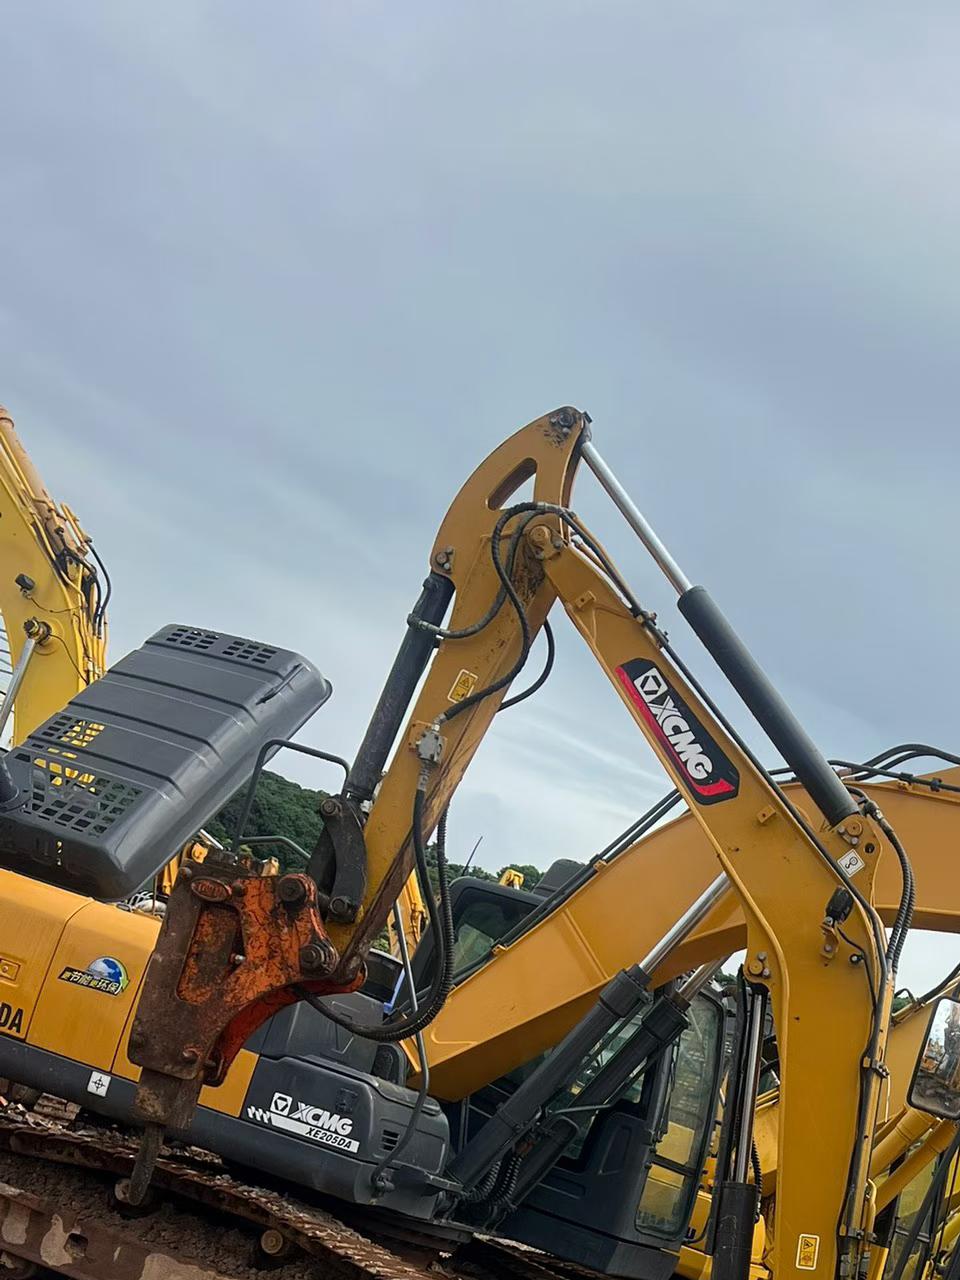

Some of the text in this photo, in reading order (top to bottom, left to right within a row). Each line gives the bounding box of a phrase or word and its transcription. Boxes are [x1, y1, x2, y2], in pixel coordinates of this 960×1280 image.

[647, 695, 713, 780] XCMG
[289, 1101, 353, 1136] XCMG
[305, 1127, 353, 1149] XE205DA
